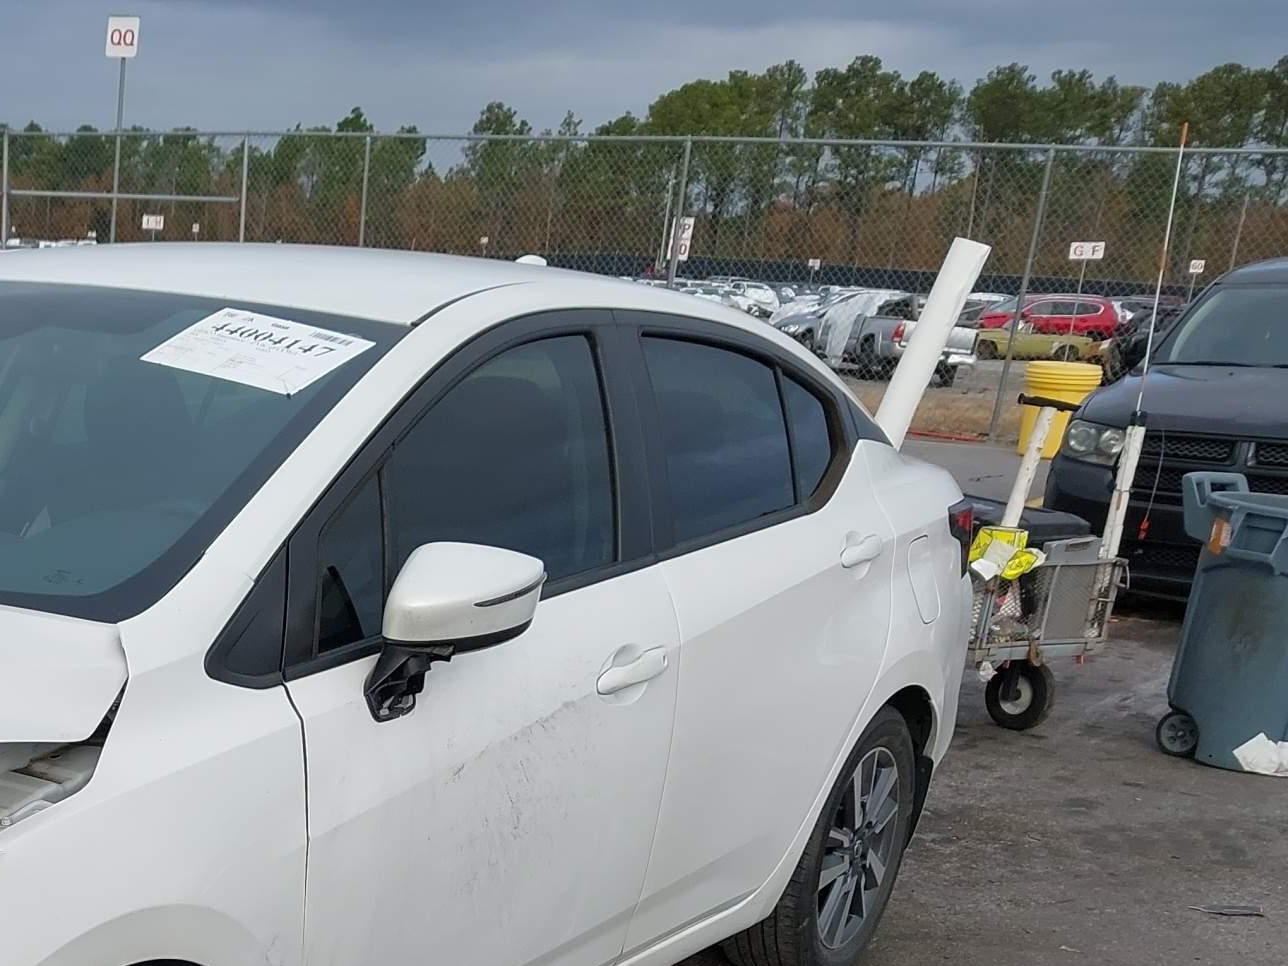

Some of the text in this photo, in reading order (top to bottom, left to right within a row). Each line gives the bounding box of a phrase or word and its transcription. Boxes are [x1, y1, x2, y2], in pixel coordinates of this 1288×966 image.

[111, 28, 134, 46] QQ
[1073, 244, 1102, 257] G F
[211, 322, 337, 358] 44004147
